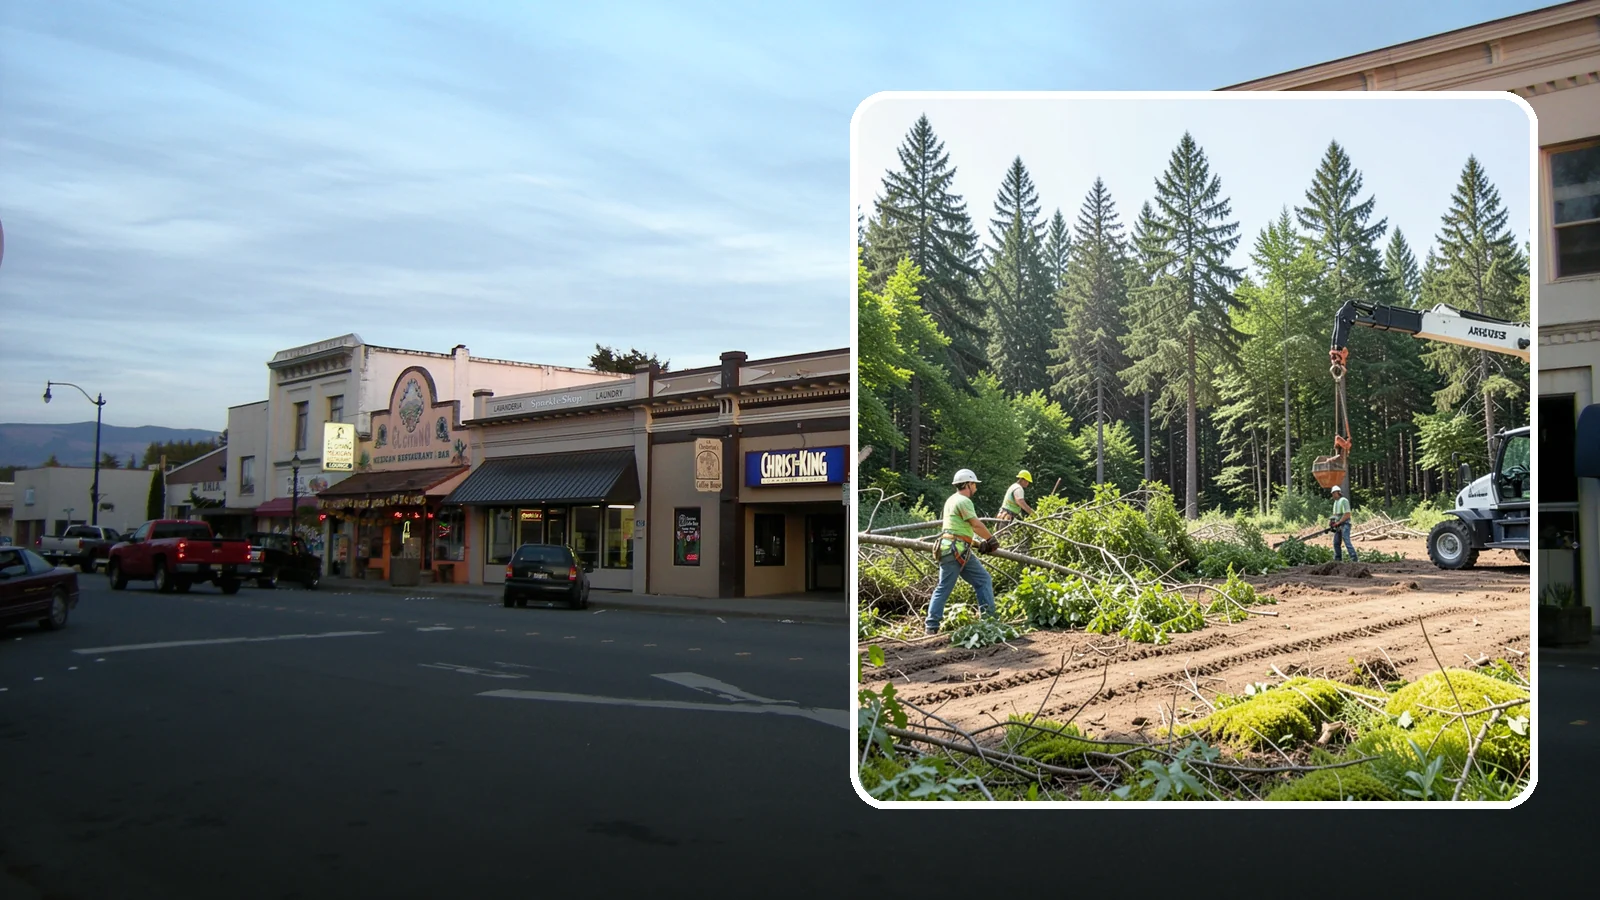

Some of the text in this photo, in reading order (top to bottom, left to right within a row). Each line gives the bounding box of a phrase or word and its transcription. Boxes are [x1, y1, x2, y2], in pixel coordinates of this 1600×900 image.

[531, 397, 561, 409] Sparkle
[562, 394, 582, 404] Shop
[595, 389, 624, 399] LAUNDRY
[373, 450, 450, 464] MEXICAN RESTAURANT BAR
[761, 450, 827, 478] CHRIST KING
